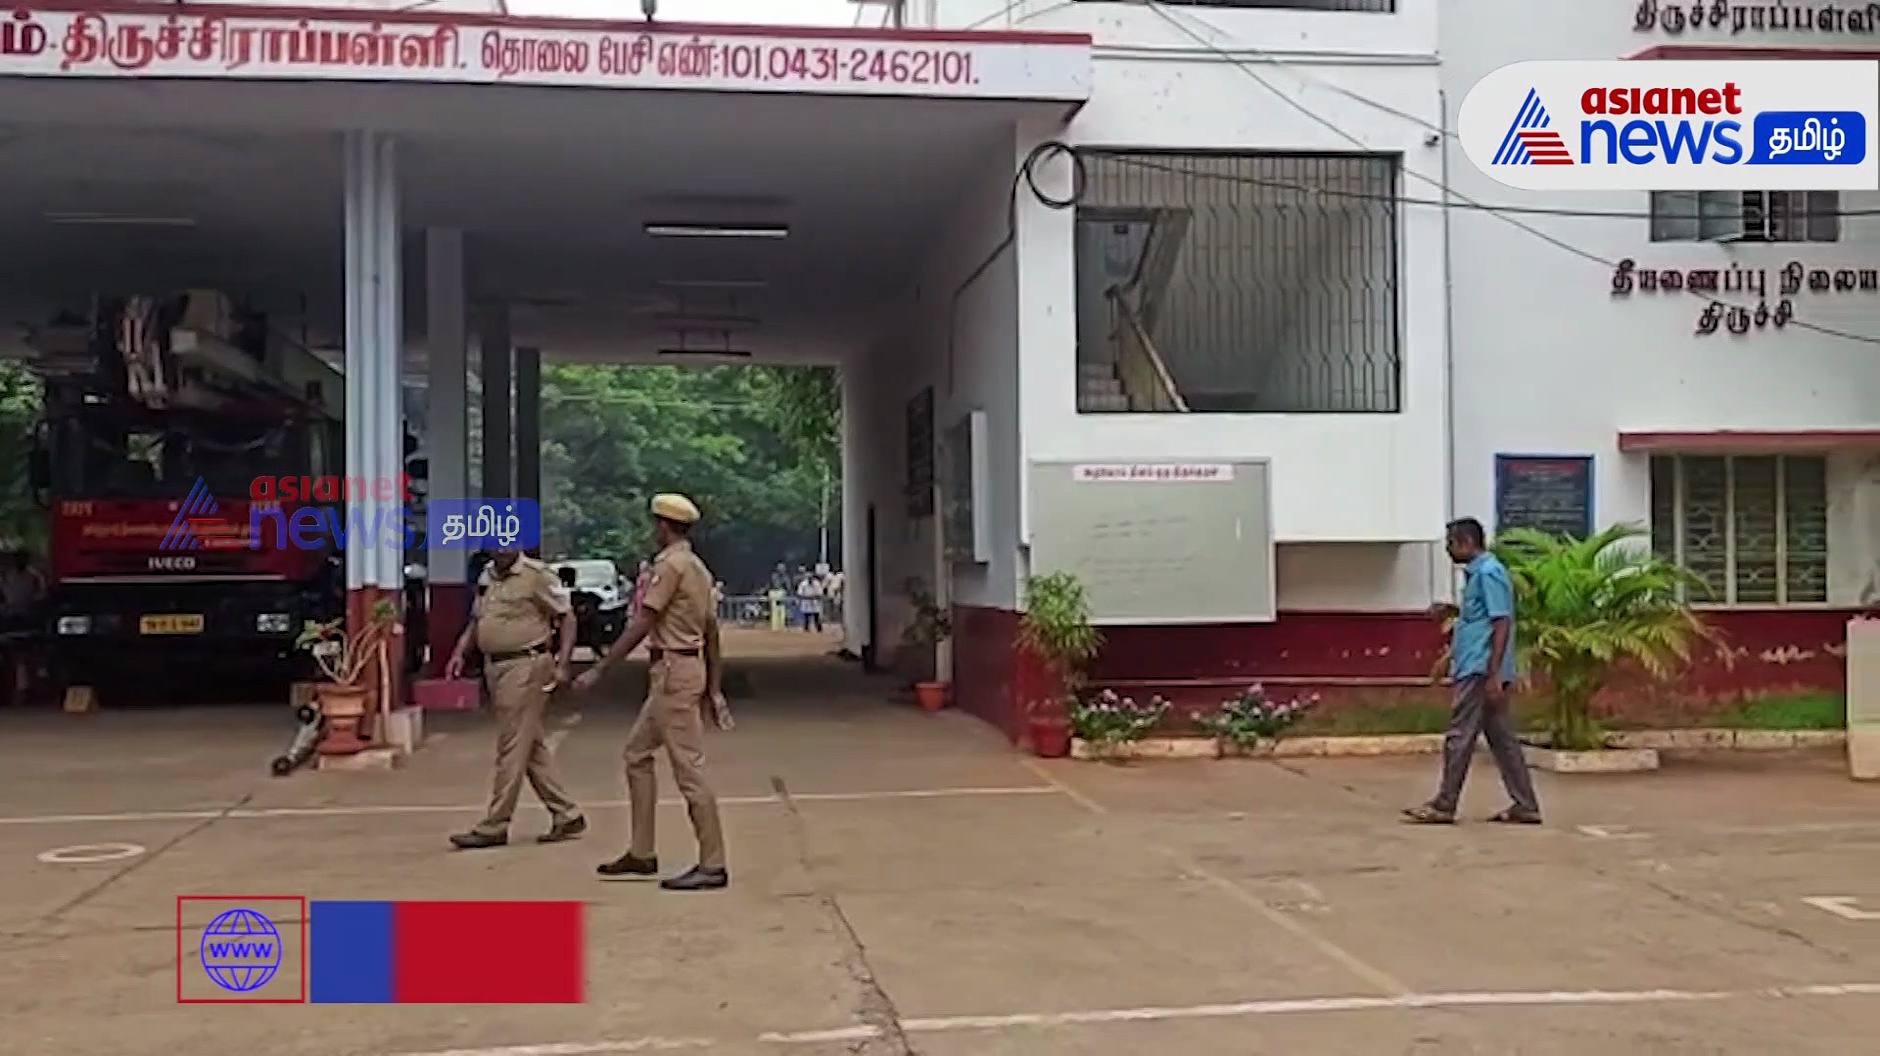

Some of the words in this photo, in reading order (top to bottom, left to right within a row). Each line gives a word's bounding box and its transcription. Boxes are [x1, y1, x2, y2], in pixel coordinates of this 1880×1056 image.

[481, 30, 588, 80] தொலை
[1611, 259, 1765, 297] தீயணைப்பு
[1695, 299, 1792, 334] திருச்சி
